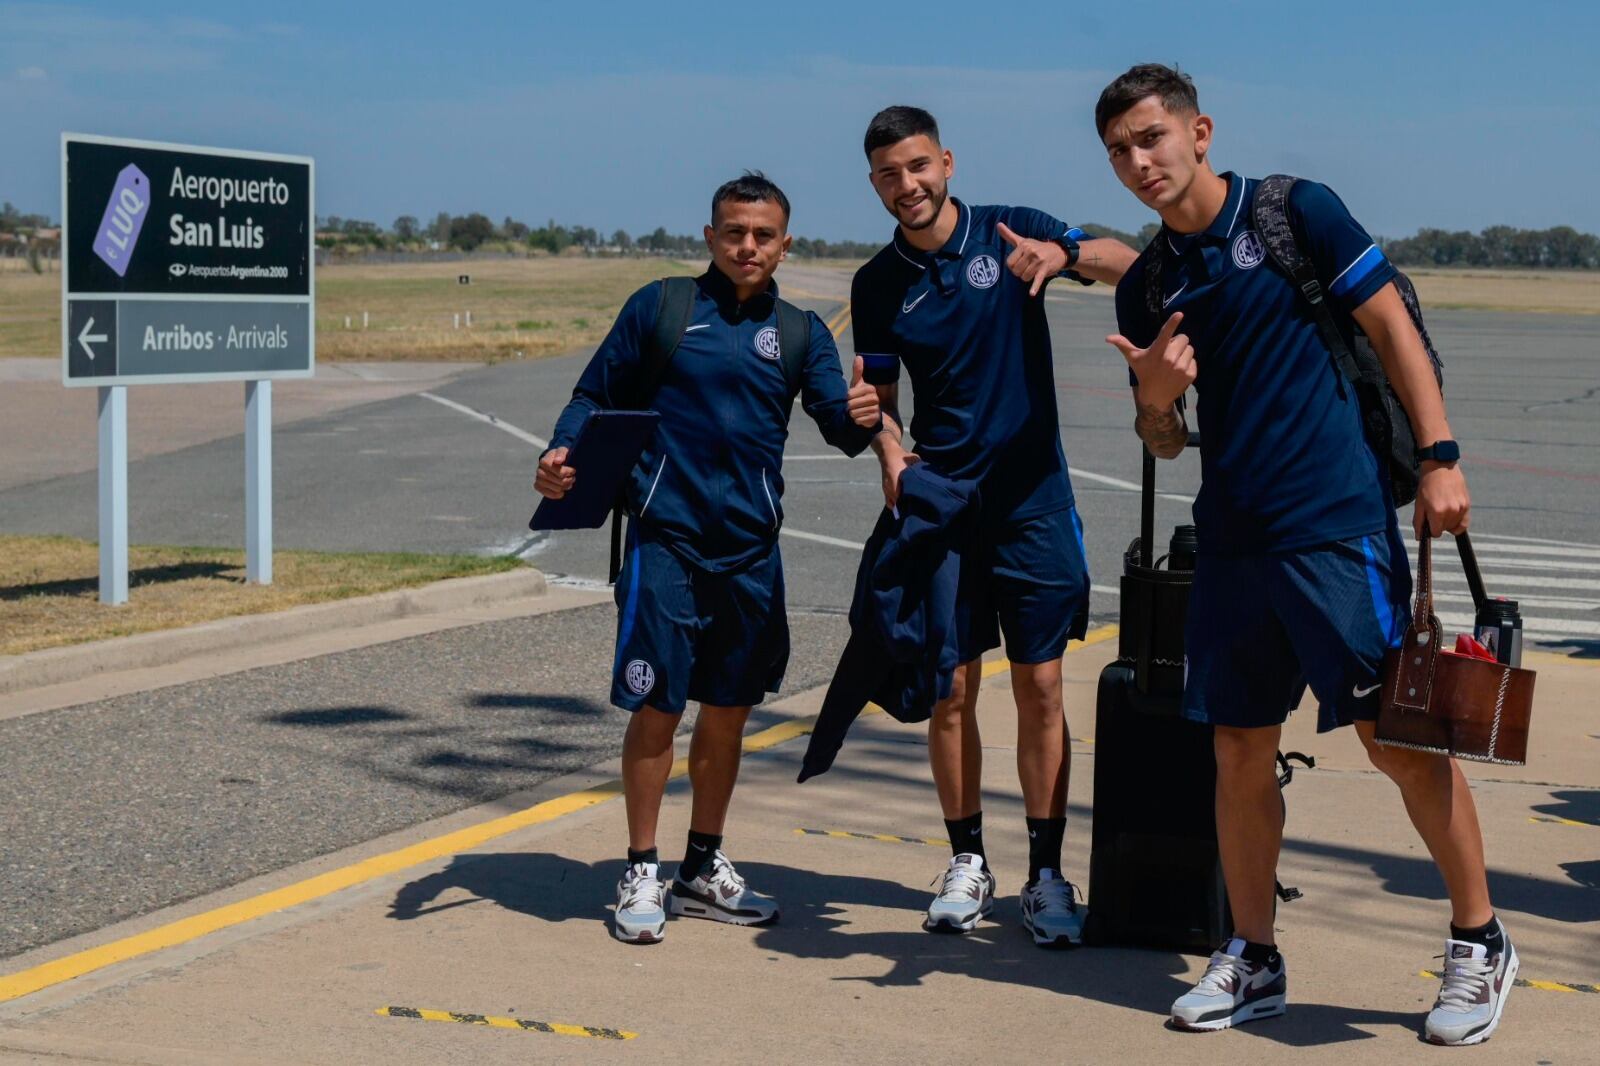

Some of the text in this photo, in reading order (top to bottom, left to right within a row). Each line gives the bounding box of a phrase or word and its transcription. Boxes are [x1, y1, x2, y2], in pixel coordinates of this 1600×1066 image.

[169, 166, 289, 208] Aeropuerto
[106, 187, 145, 252] LUQ
[169, 213, 264, 249] San Luis
[142, 323, 288, 351] Arribos Arrivals
